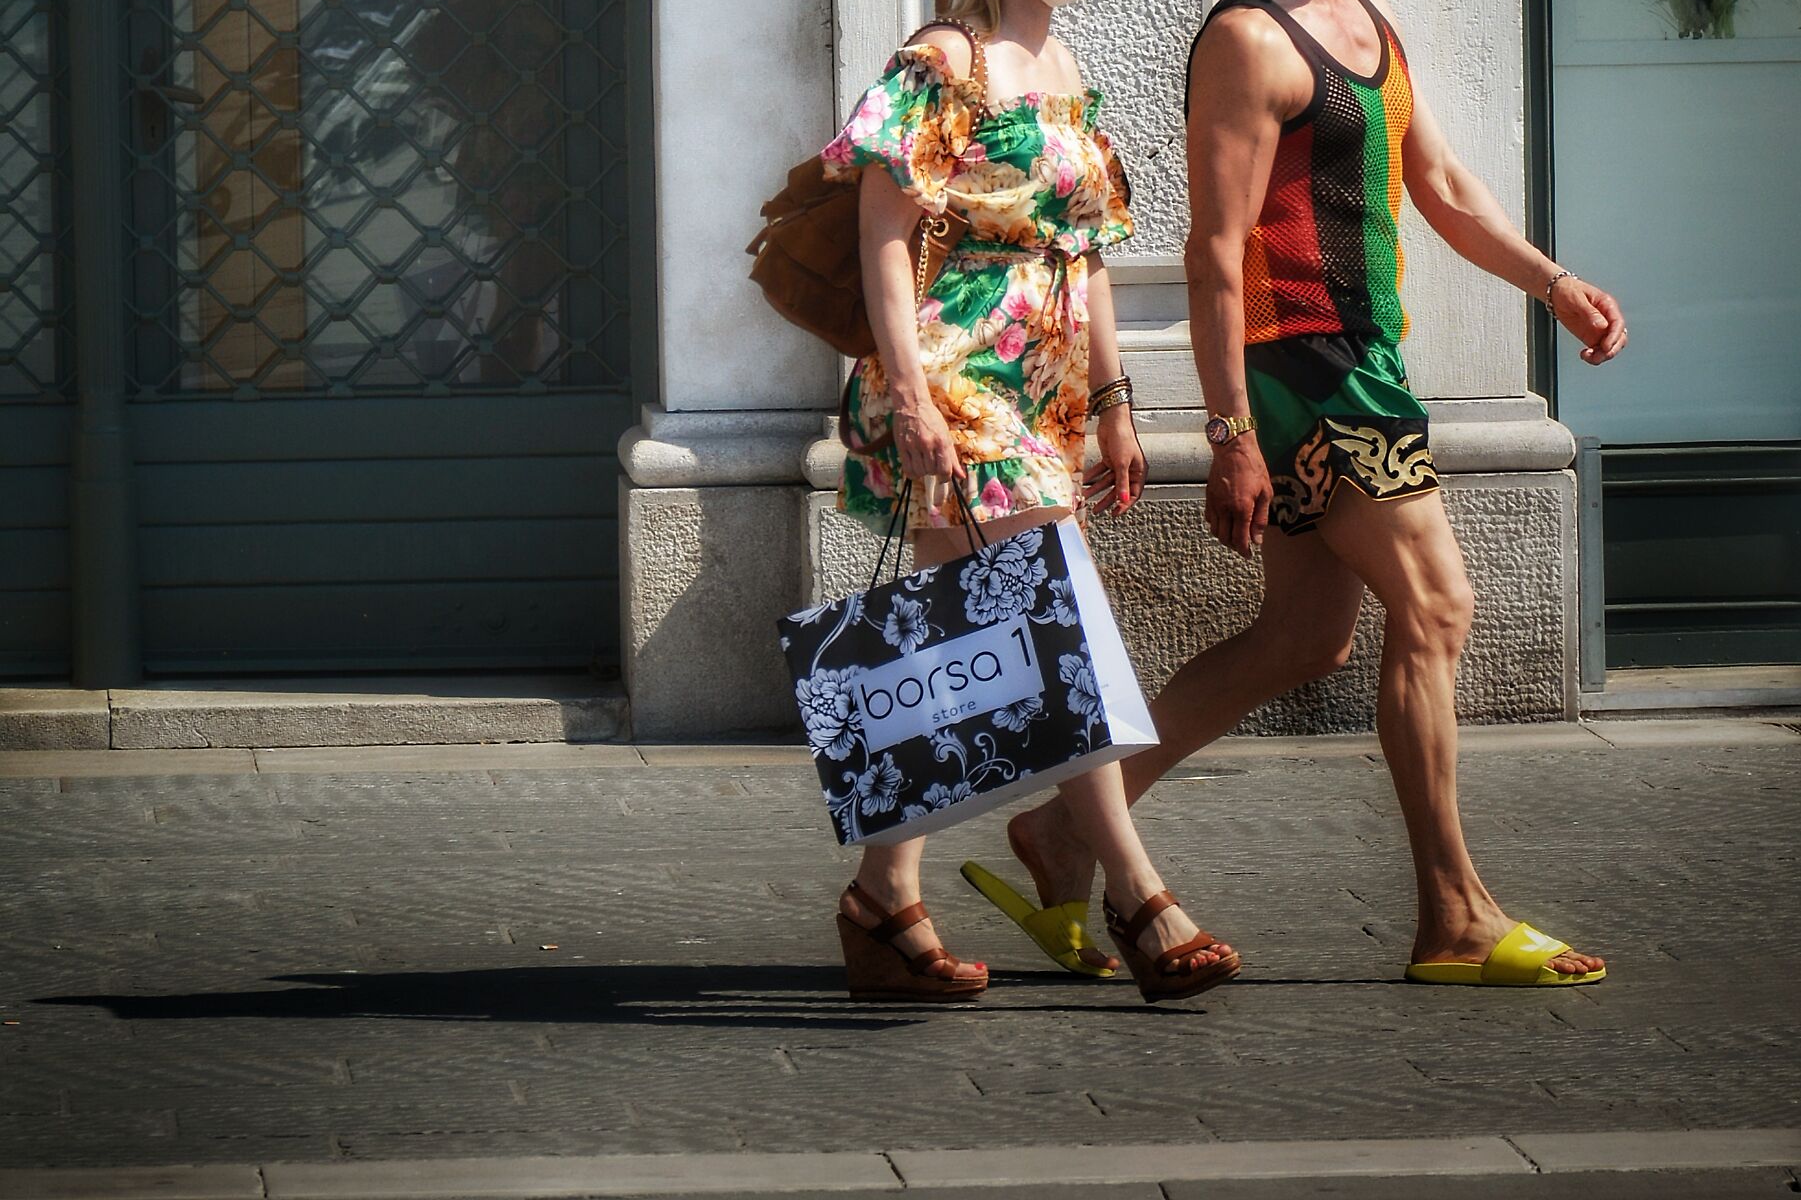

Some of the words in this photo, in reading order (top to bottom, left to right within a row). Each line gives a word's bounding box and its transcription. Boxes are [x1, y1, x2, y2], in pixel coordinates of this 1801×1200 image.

[860, 651, 1003, 720] borsa
[1011, 627, 1031, 667] 1
[932, 700, 977, 723] store
